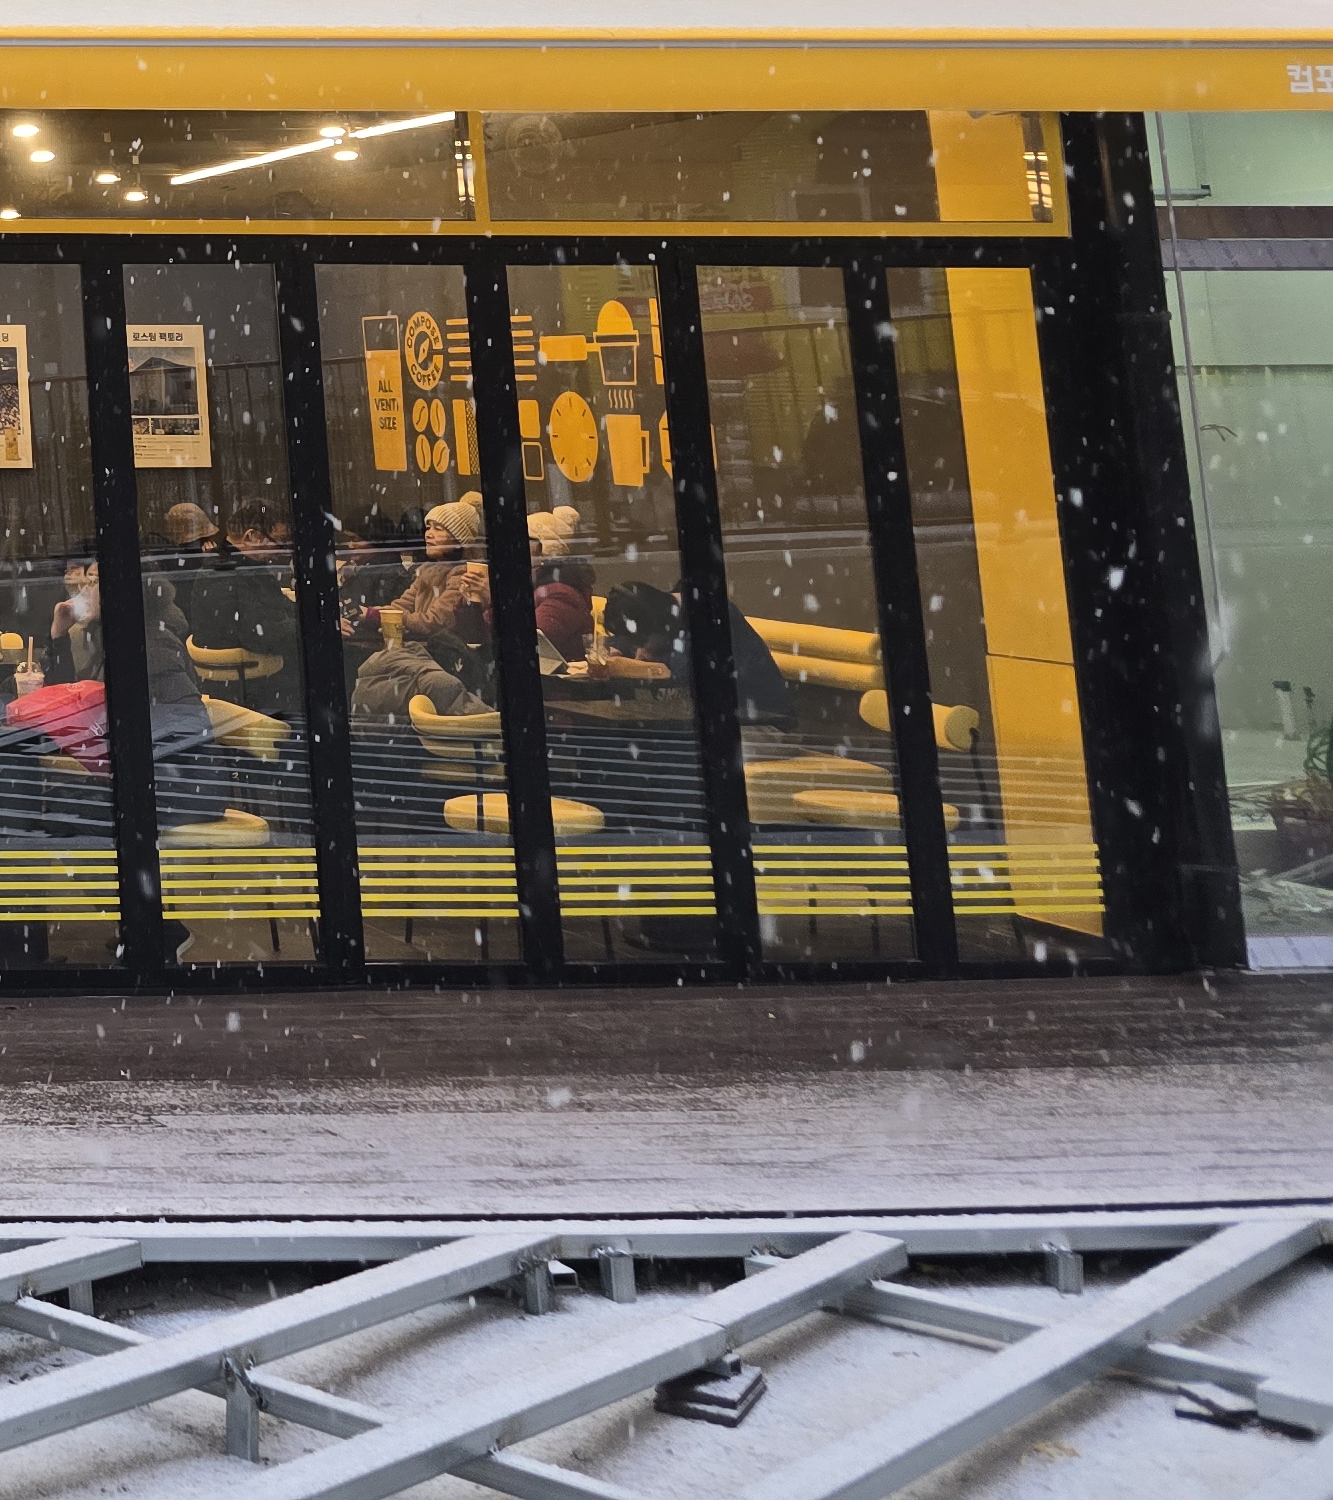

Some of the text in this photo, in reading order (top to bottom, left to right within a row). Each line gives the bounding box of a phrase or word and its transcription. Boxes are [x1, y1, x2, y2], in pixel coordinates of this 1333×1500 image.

[406, 315, 442, 350] COMPOSE
[410, 363, 442, 386] COFFEE
[378, 379, 394, 393] ALL
[374, 397, 399, 412] VENTI
[378, 416, 397, 431] SIZE
